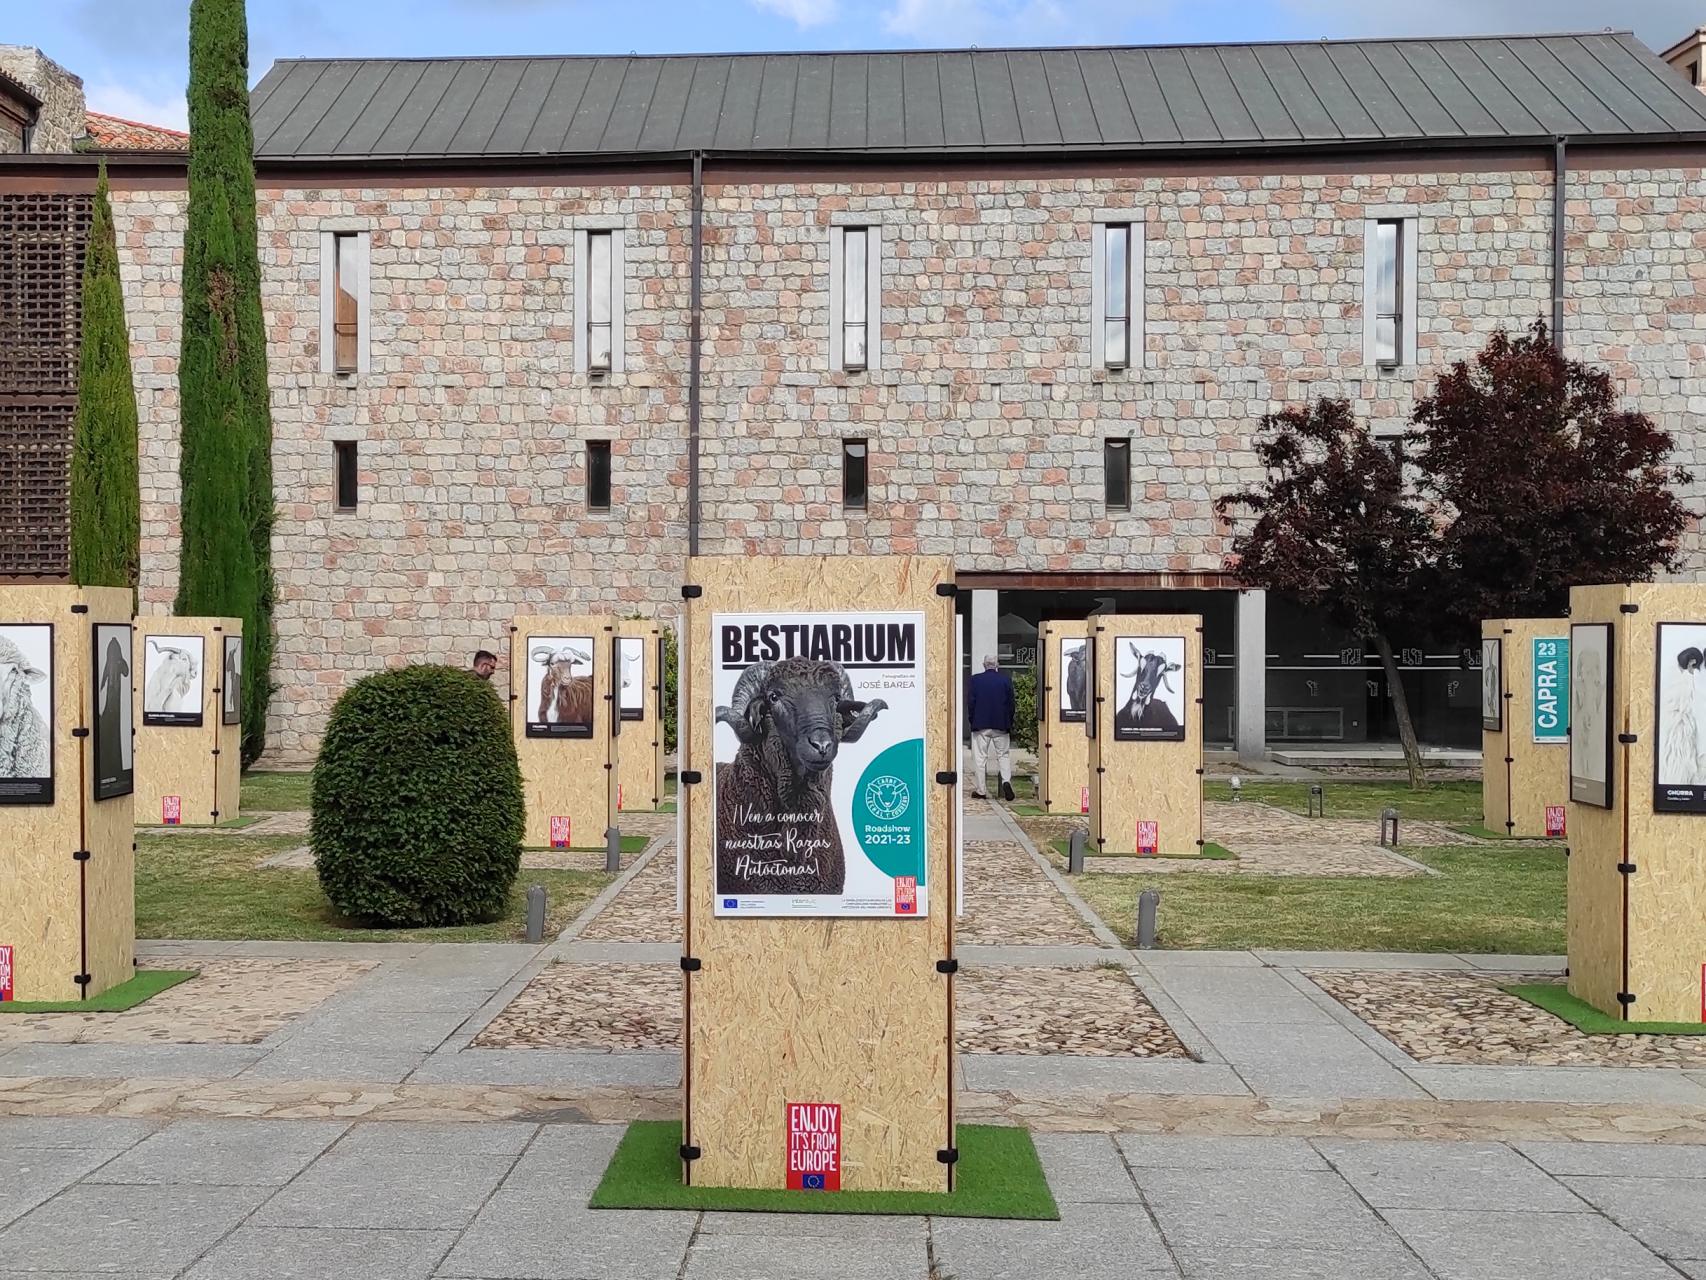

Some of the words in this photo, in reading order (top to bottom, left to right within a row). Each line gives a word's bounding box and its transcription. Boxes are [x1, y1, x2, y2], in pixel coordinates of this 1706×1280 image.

[722, 624, 915, 662] BESTIARIUM
[1537, 642, 1557, 656] 23
[858, 680, 881, 689] JOSÉ
[883, 681, 916, 689] BAREA
[1537, 660, 1558, 729] CAPRA
[765, 813, 776, 822] a
[777, 808, 824, 823] conocer
[865, 824, 910, 832] Roadshow
[725, 832, 782, 850] nuestras
[786, 827, 831, 858] Razas
[865, 834, 910, 844] 2021-23
[791, 1106, 837, 1132] ENJOY
[791, 1132, 809, 1150] IT'S
[811, 1132, 837, 1150] FROM
[791, 1150, 837, 1172] EUROPE
